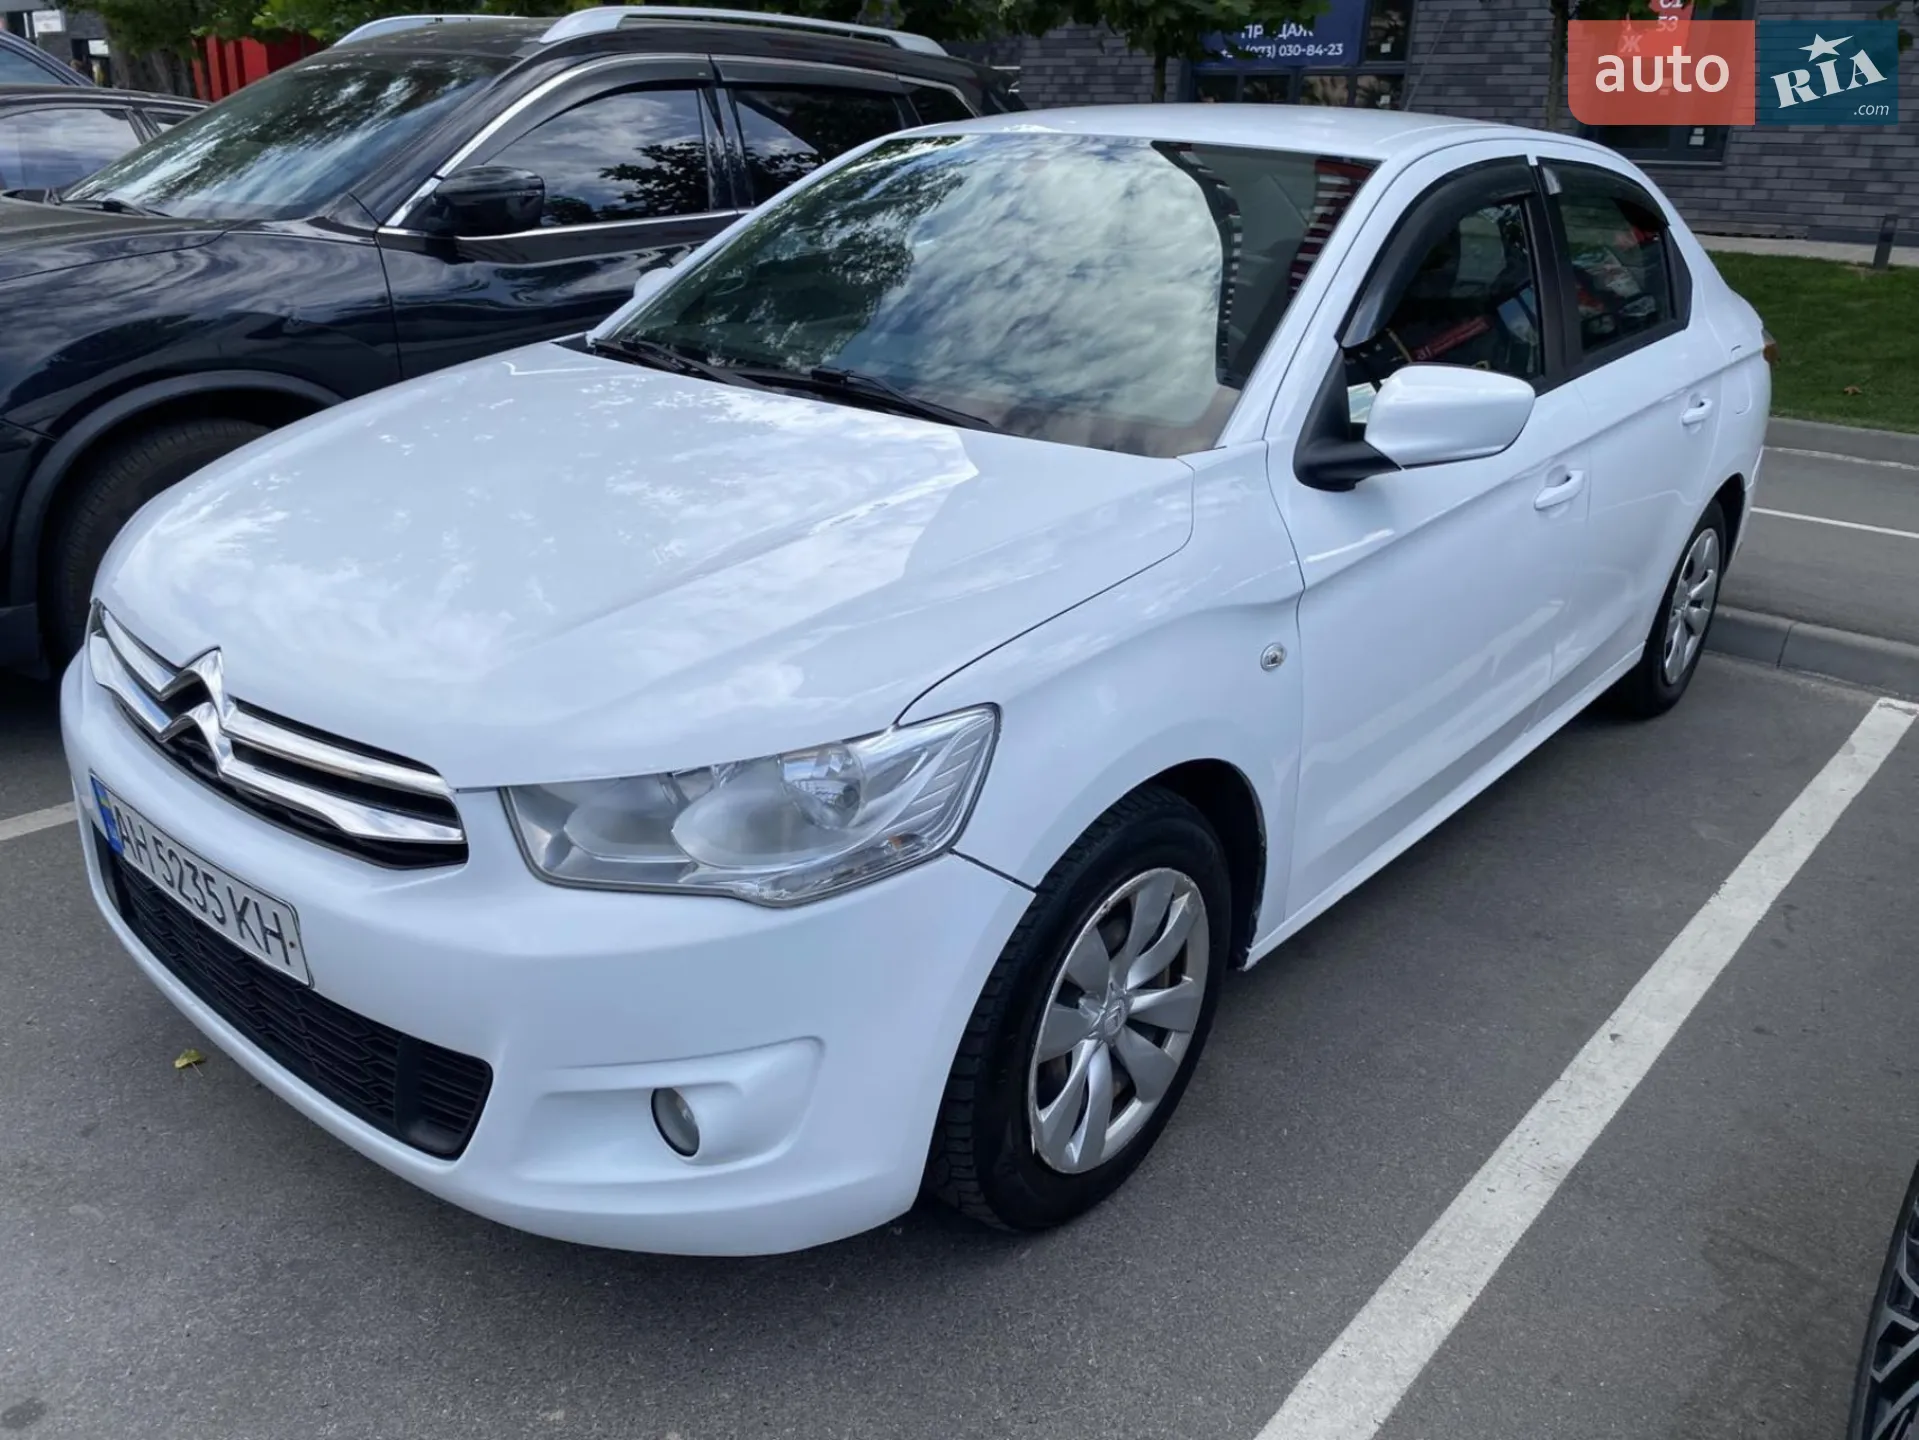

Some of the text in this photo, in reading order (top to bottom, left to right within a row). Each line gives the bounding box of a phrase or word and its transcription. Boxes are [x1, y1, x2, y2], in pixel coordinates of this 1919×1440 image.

[1279, 43, 1344, 57] 030-84-23
[152, 835, 226, 926] 5235
[226, 885, 291, 967] KH
